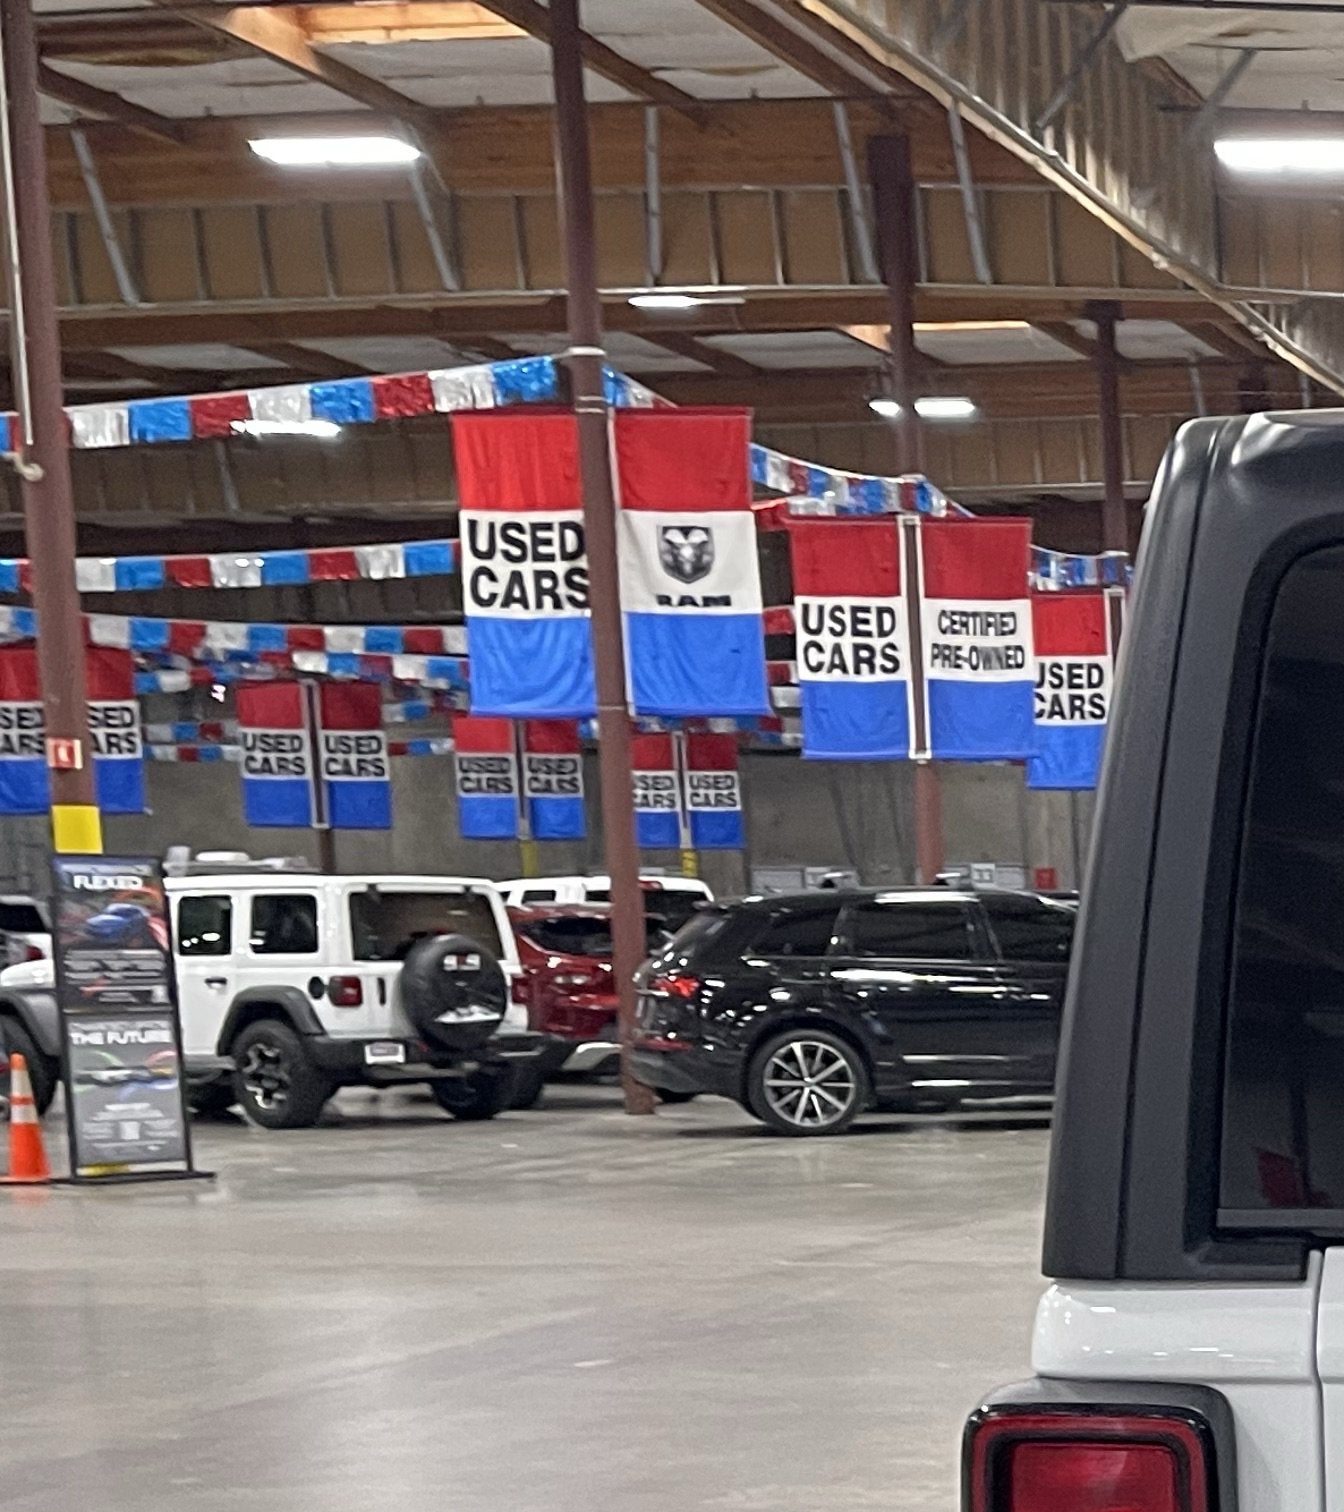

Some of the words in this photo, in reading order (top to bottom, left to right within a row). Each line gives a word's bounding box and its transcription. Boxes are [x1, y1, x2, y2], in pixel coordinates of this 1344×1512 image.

[468, 519, 584, 563] USED
[470, 566, 589, 610] CARS
[801, 604, 896, 638] USED
[938, 609, 1017, 636] CERTIFIED
[803, 641, 900, 675] CARS
[931, 643, 1024, 671] PRE-OWNED
[88, 707, 135, 728] SED
[91, 732, 137, 754] ARS
[242, 734, 304, 753] USED
[325, 735, 383, 755] USED
[244, 756, 306, 775] CARS
[325, 757, 385, 776] CARS
[458, 757, 511, 774] USED
[527, 757, 578, 775] USED
[460, 776, 513, 794] CARS
[528, 776, 580, 794] CARS
[635, 775, 675, 791] SED
[688, 774, 735, 791] USED
[690, 791, 738, 808] CARS
